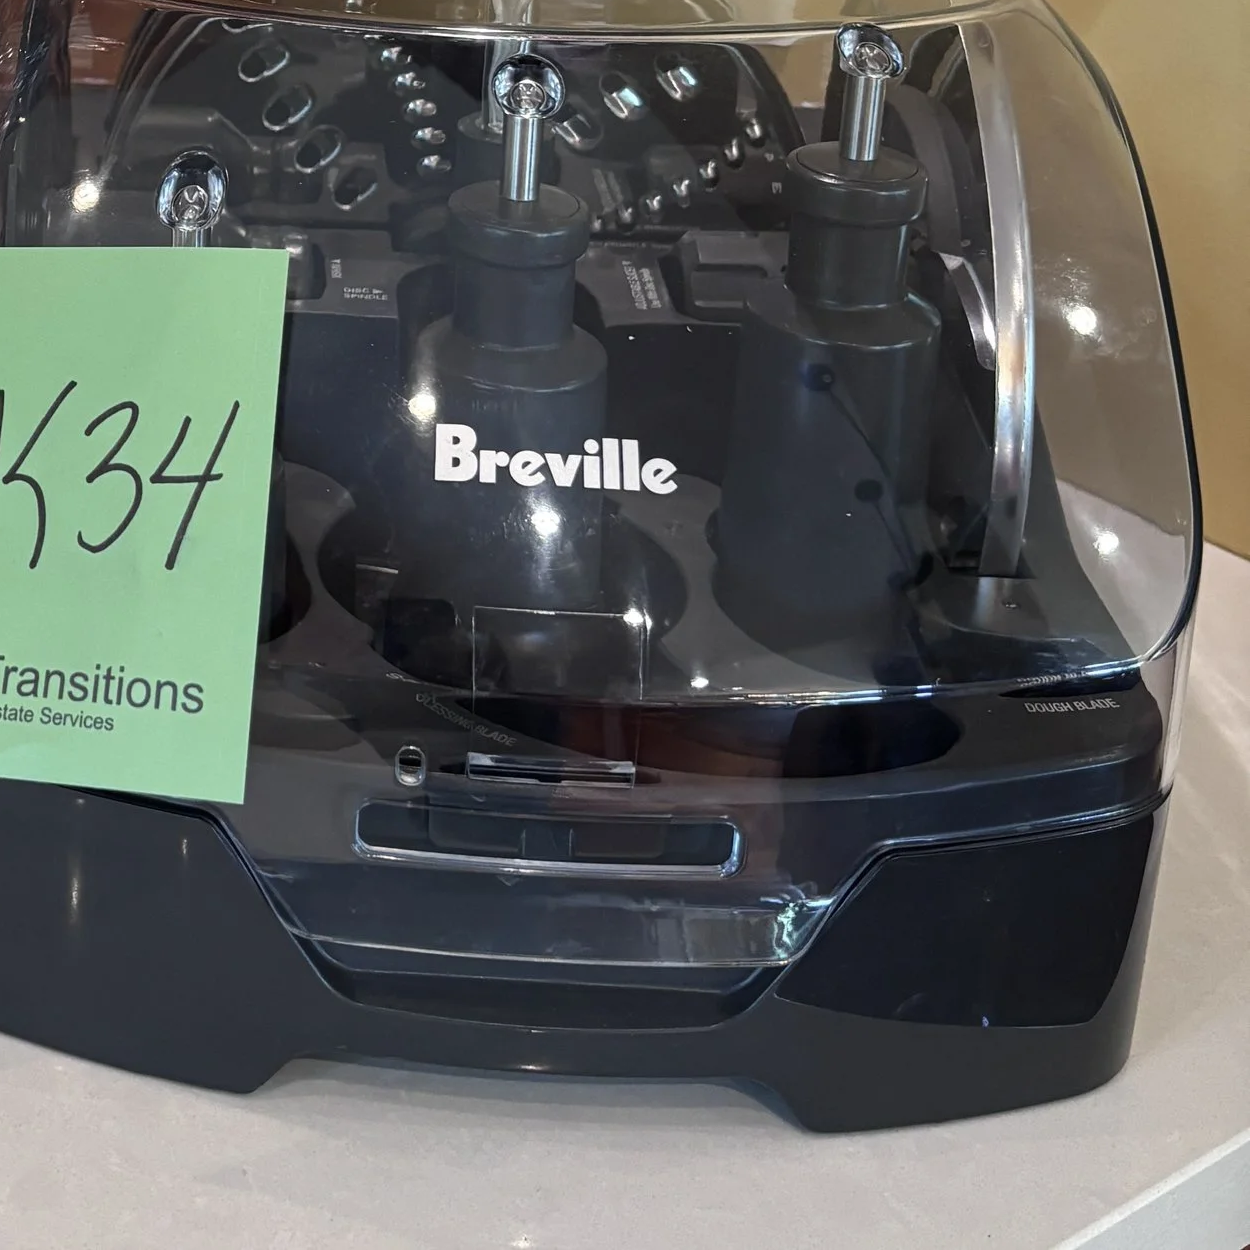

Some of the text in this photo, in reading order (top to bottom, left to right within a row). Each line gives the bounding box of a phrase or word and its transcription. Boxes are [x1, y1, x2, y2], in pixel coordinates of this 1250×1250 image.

[434, 423, 679, 495] Breville
[1024, 698, 1121, 714] DOUGH BLADE
[39, 707, 115, 733] Services
